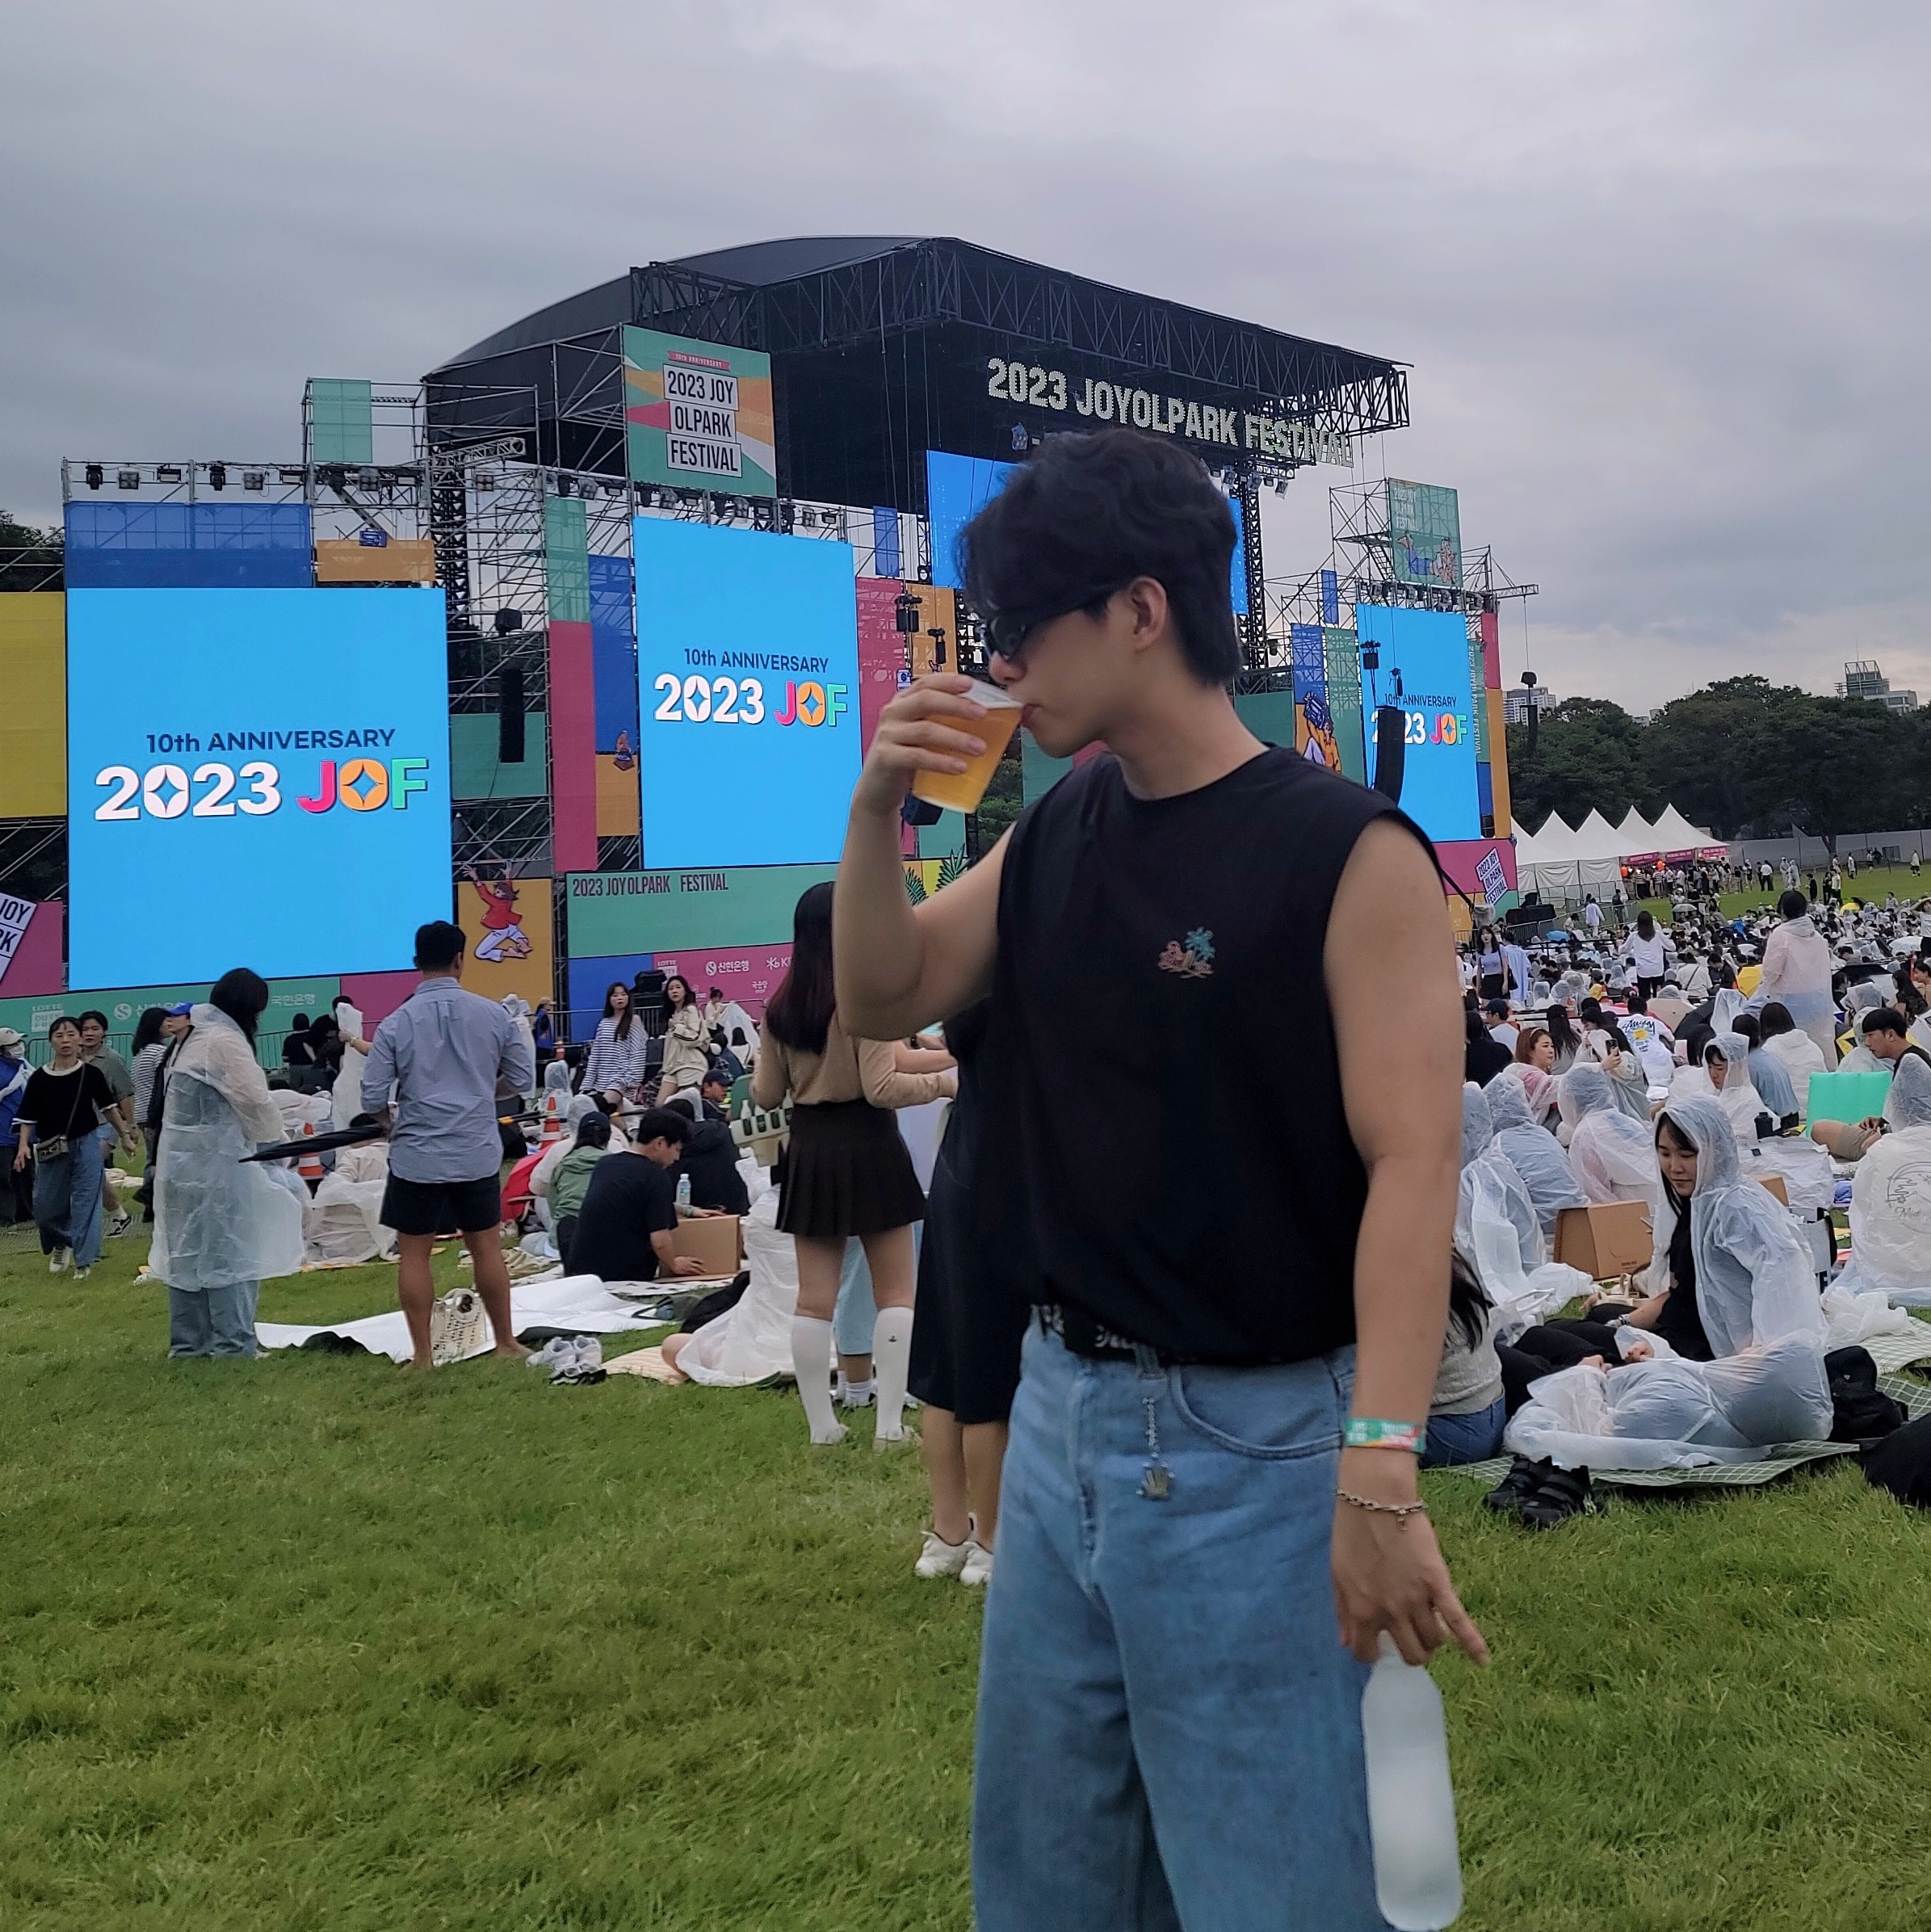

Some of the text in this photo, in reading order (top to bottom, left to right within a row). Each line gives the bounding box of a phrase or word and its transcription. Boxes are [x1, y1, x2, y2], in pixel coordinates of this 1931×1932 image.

[667, 370, 733, 404] 2023 JOY
[674, 405, 732, 438] OLPARK
[987, 356, 1354, 468] 2023 JOYOLPARK FESTIVAL
[670, 439, 738, 472] FESTIVAL
[684, 648, 829, 673] 10th ANNIVERSARY
[654, 673, 848, 727] 2023 JOF
[1402, 694, 1457, 708] ANNIVERSARY
[146, 729, 396, 754] 10th ANNIVERSARY
[1429, 712, 1468, 745] JOF
[94, 758, 429, 821] 2023 JOF
[573, 872, 729, 897] 2023 JOYOLPARK FESTIVAL
[718, 960, 749, 973] 신한은행
[271, 993, 317, 1007] 국민은행
